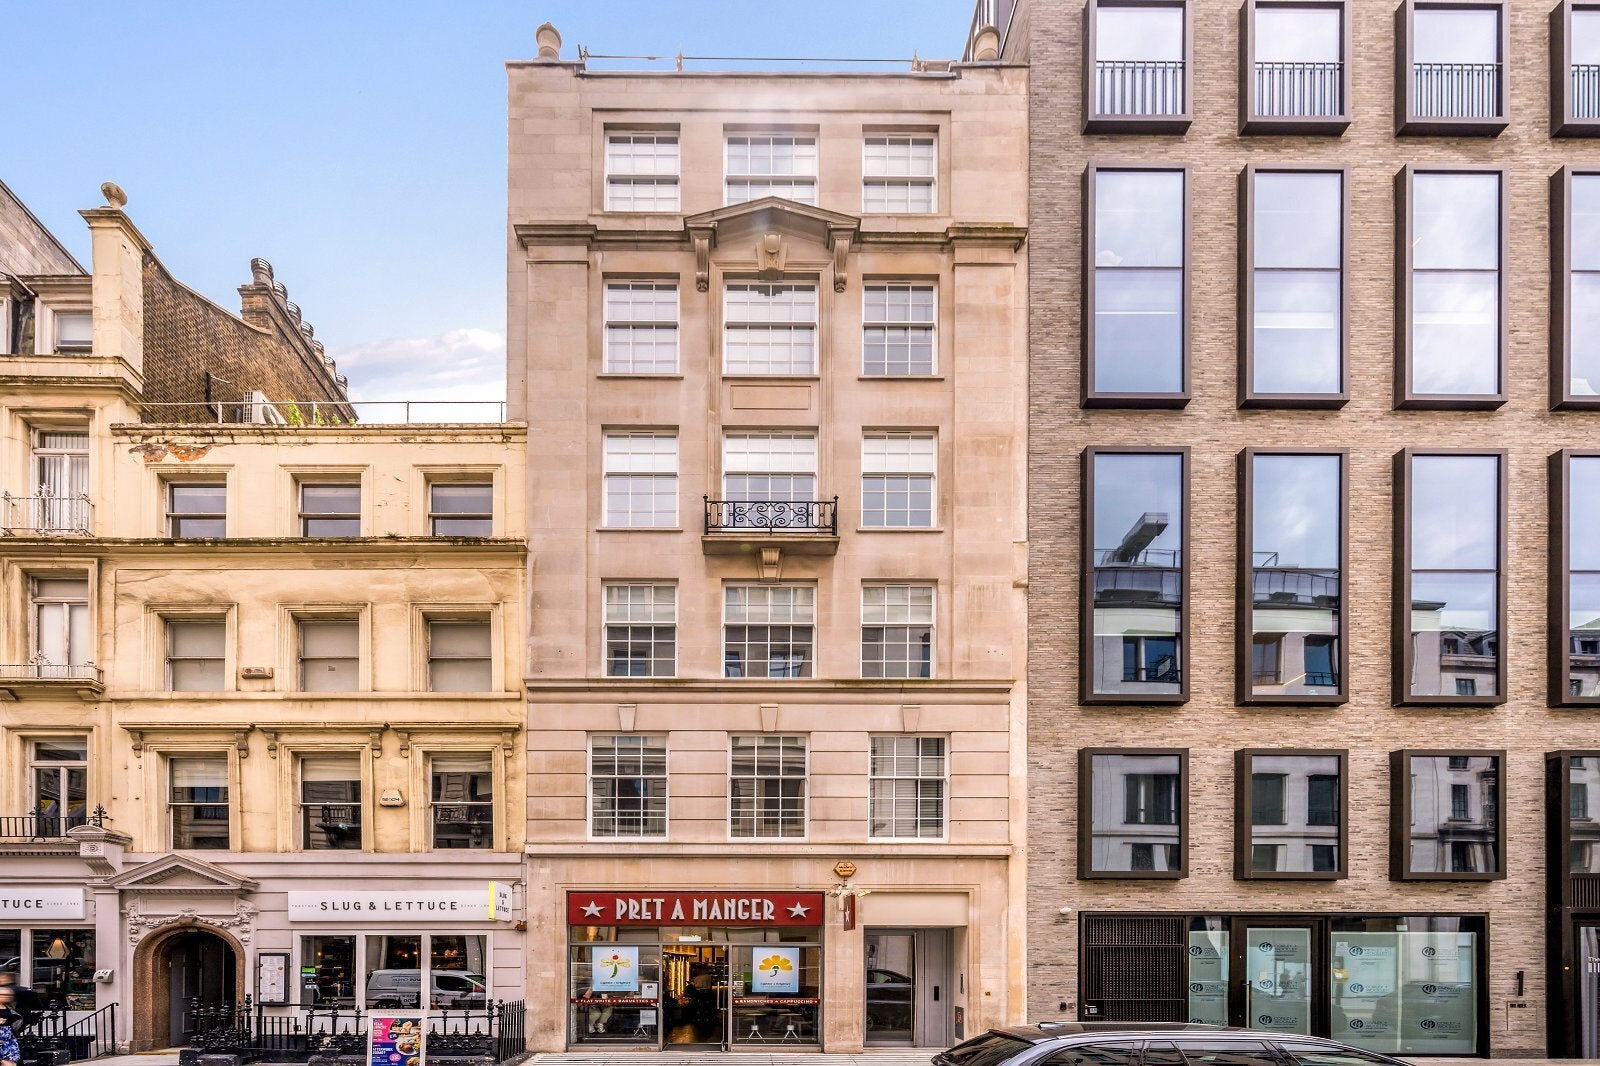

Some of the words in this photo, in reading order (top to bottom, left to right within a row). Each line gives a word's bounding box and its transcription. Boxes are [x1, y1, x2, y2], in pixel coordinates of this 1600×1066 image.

[2, 899, 43, 908] TUCE
[320, 901, 361, 910] SLUG
[368, 901, 376, 910] &
[384, 901, 457, 910] LETTUCE
[615, 898, 665, 920] PRET
[671, 898, 687, 920] A
[693, 898, 775, 920] MANGER
